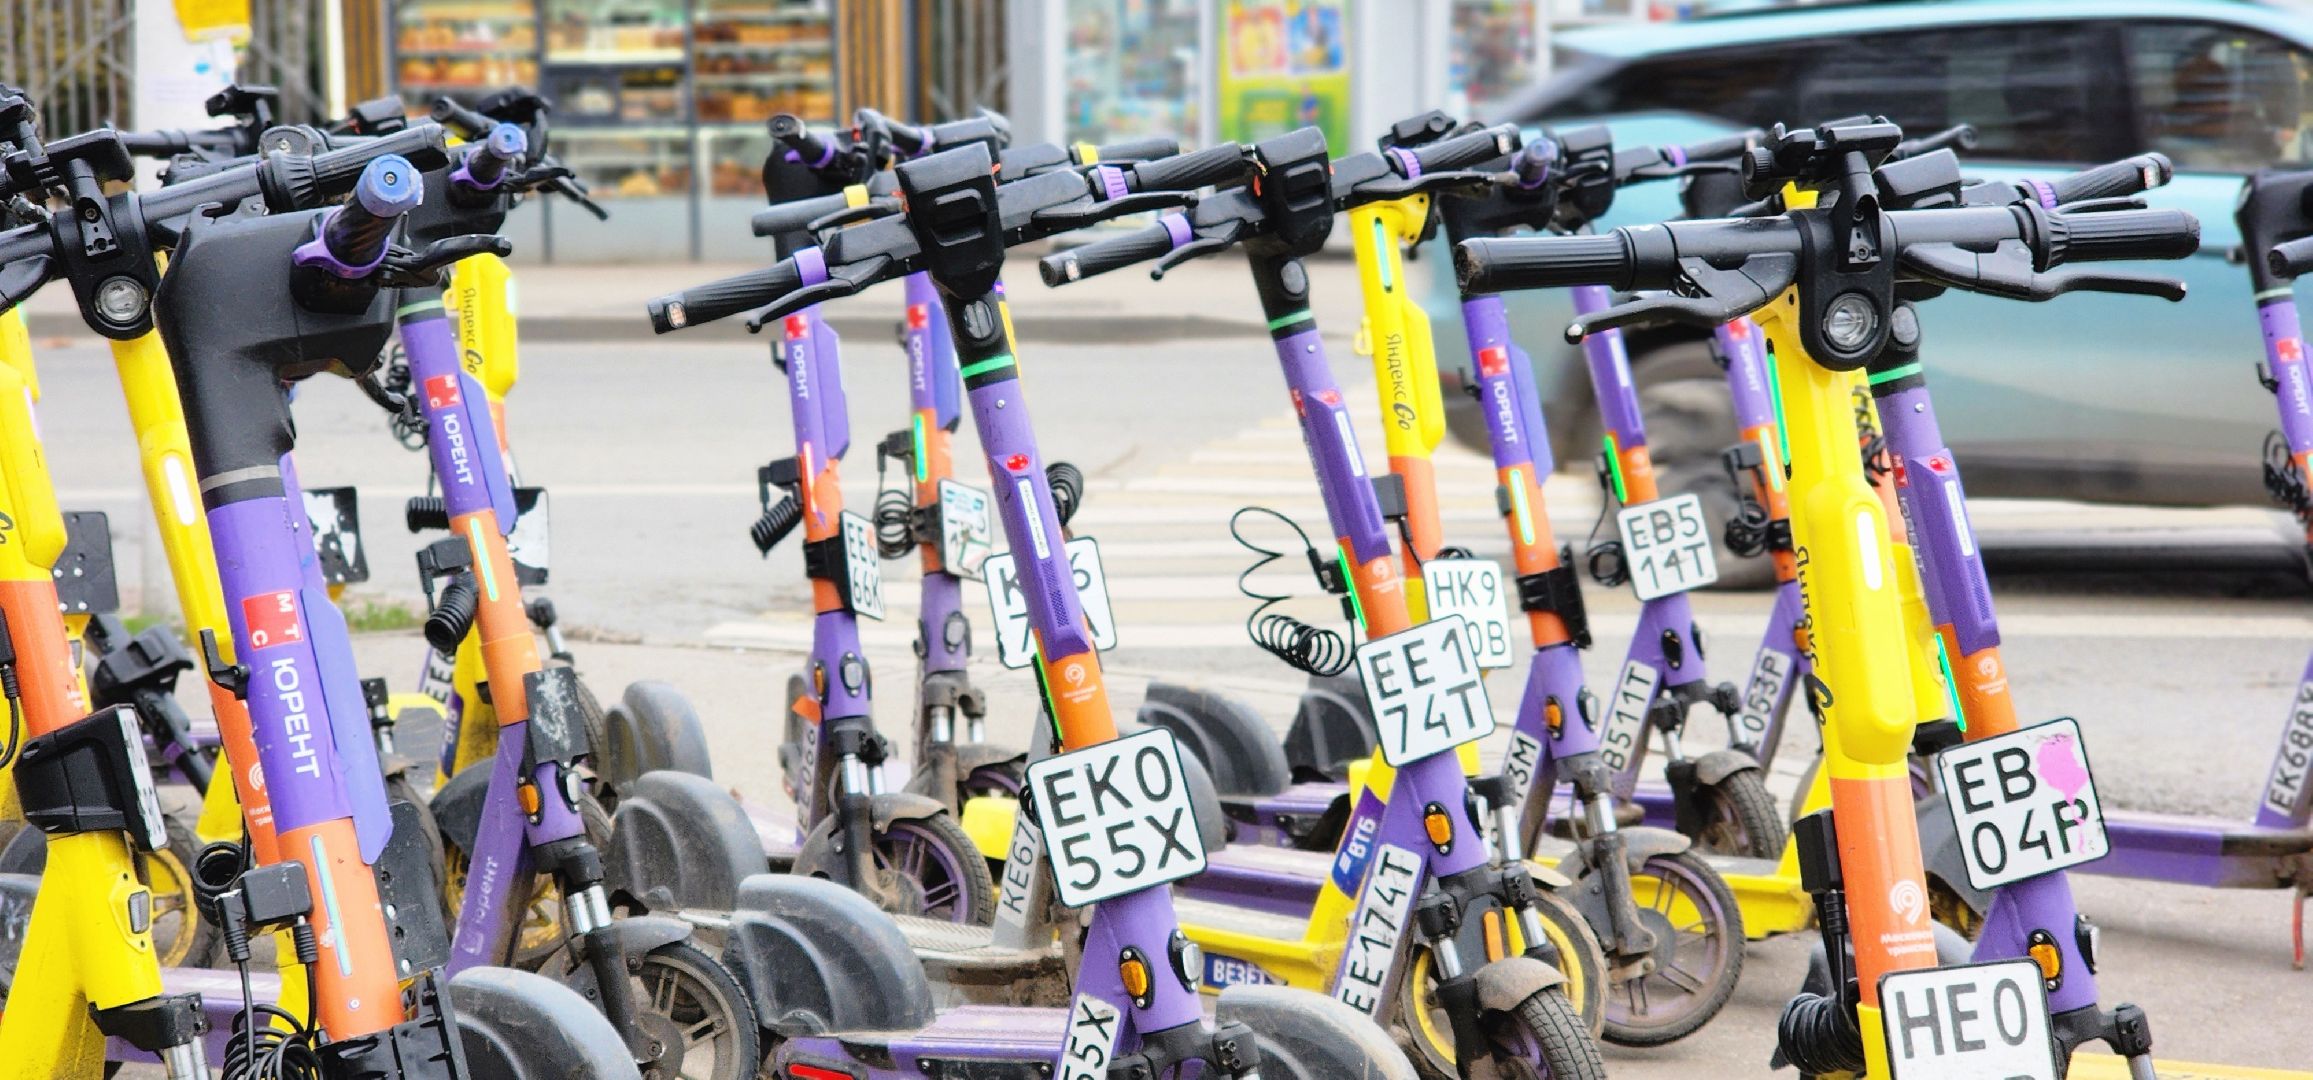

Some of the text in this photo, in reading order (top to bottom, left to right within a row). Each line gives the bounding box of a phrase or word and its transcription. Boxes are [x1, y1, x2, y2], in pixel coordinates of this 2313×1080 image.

[793, 344, 809, 400] ЮРЕНТ
[1385, 333, 1416, 430] Яндекс Go
[1493, 381, 1518, 444] ЮРЕНТ
[442, 413, 474, 486] ЮРЕНТ
[999, 552, 1091, 606] К6
[1468, 620, 1506, 656] 0В
[272, 657, 320, 779] ЮРЕНТ
[1350, 815, 1376, 859] ВТБ
